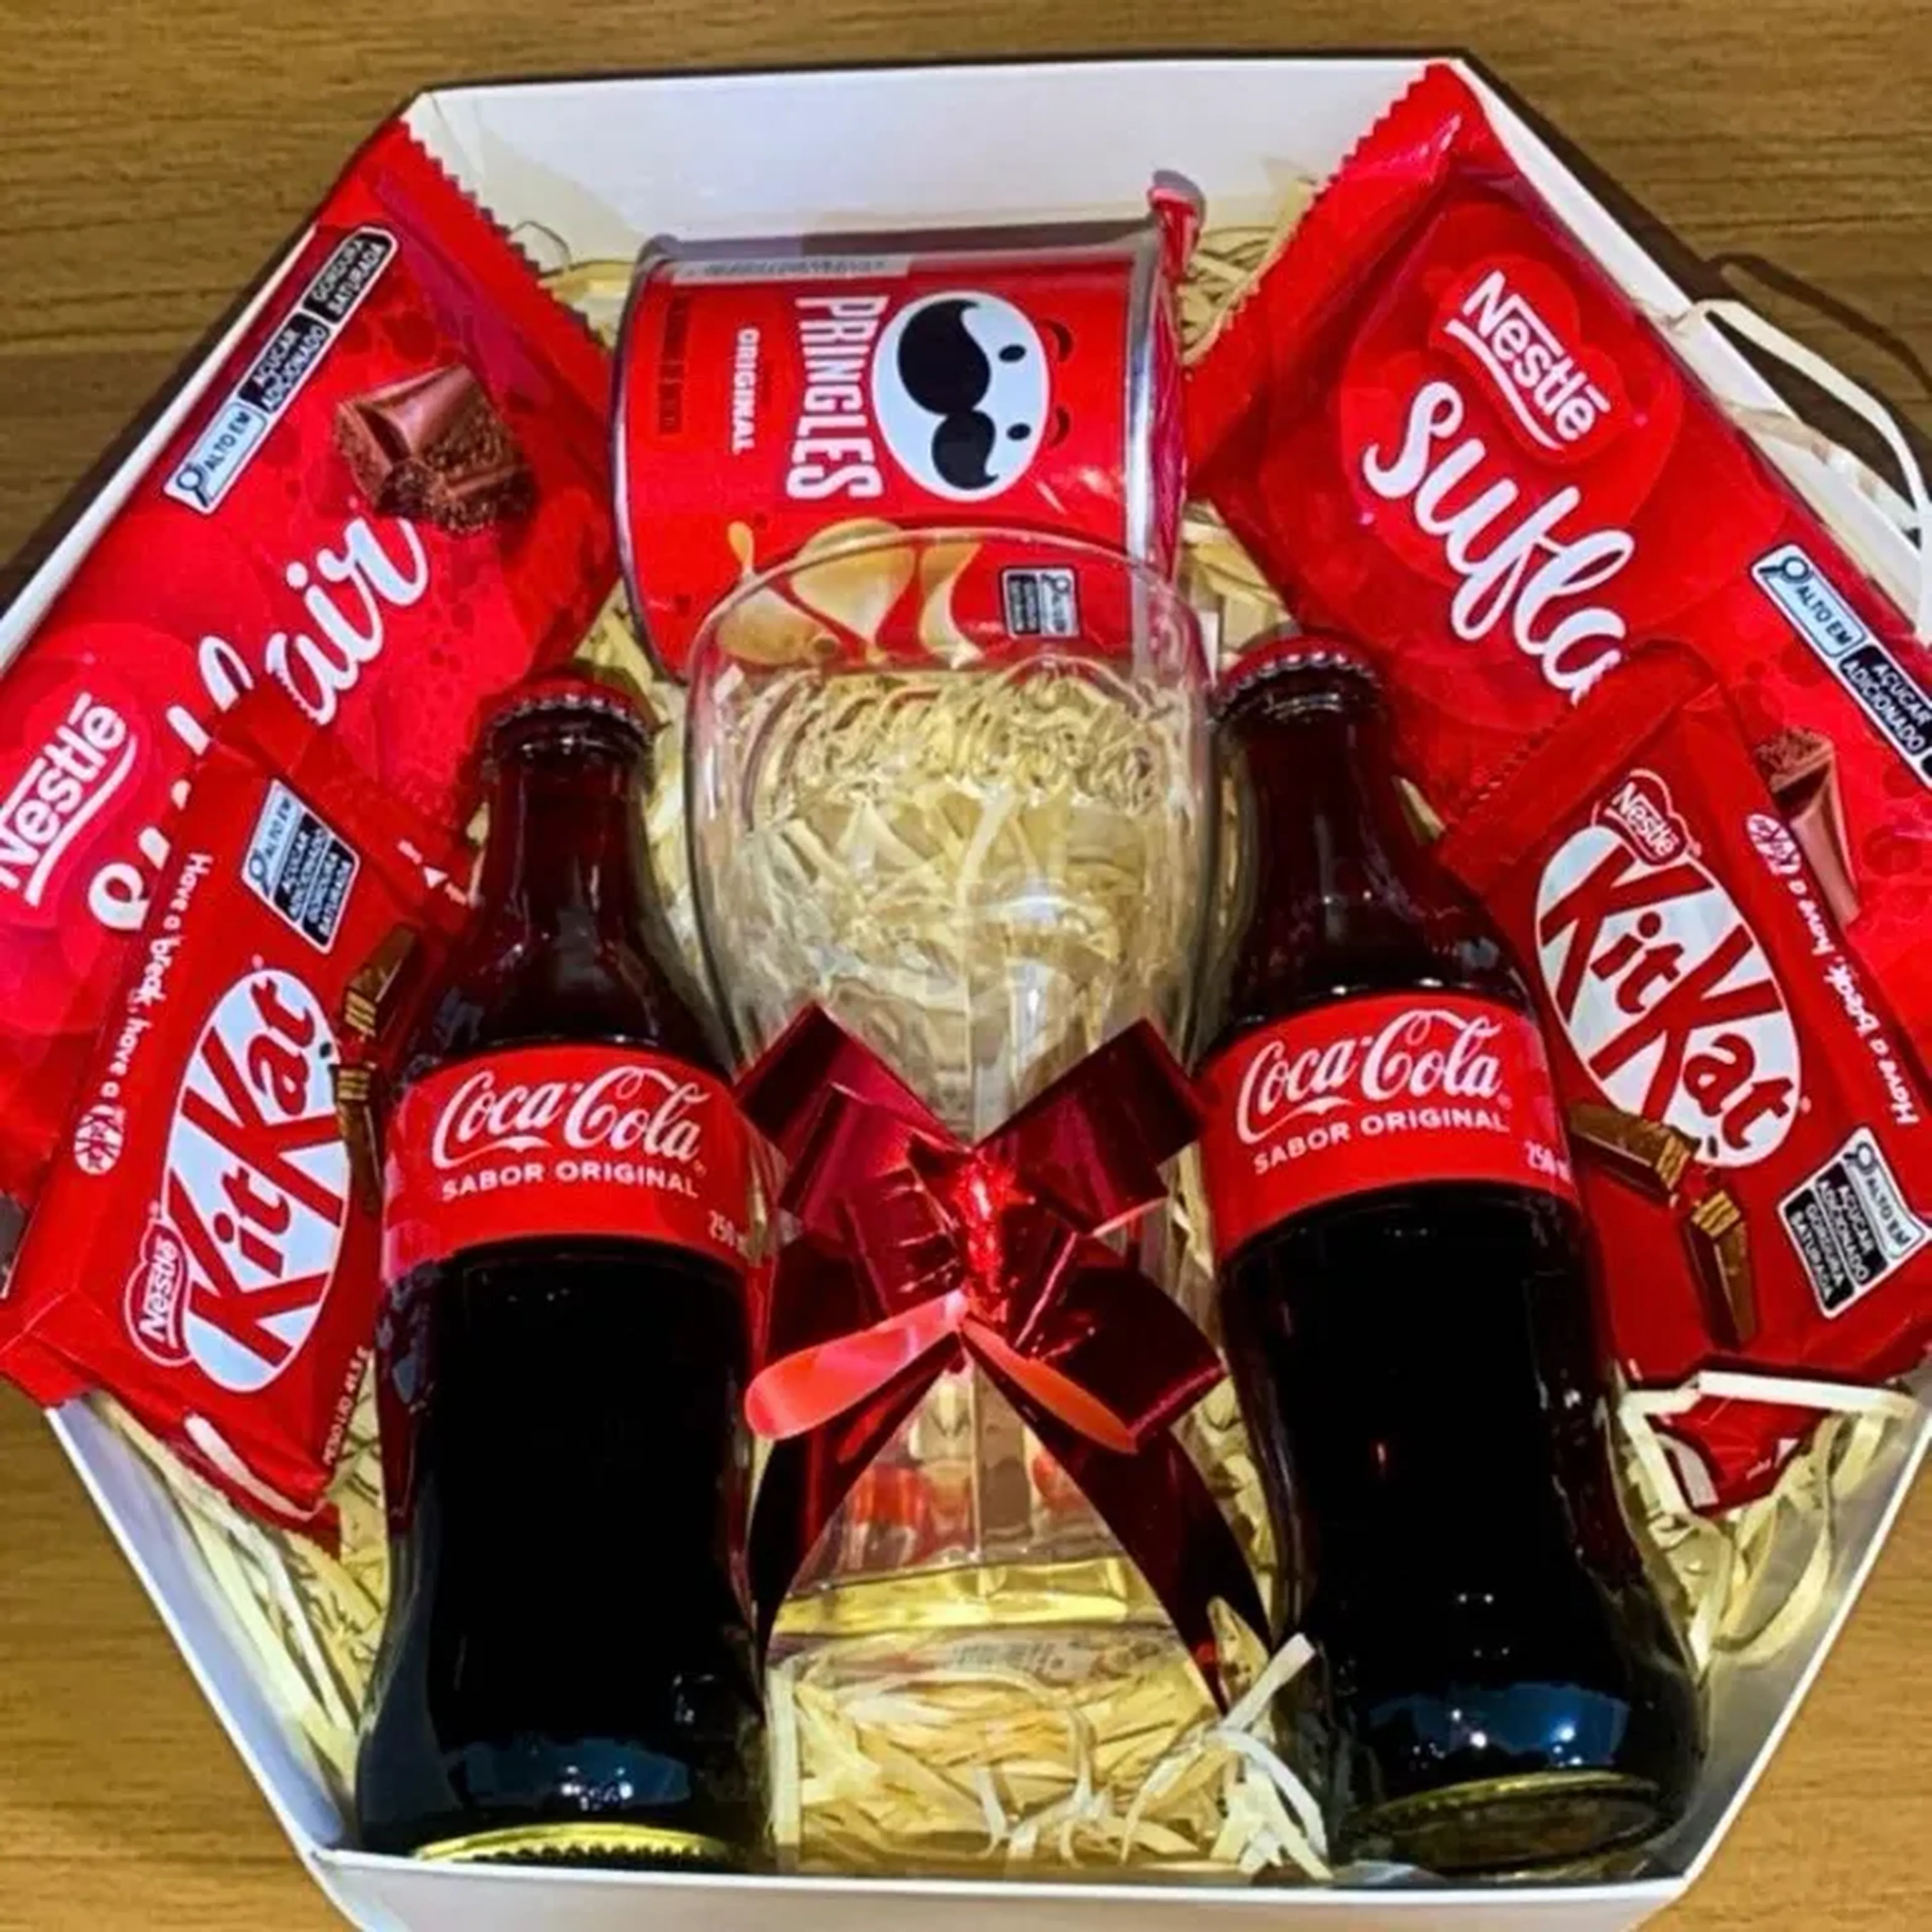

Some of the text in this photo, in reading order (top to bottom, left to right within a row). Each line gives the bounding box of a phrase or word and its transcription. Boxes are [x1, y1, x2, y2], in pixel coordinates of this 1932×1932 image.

[328, 243, 386, 315] SATURADA
[261, 325, 328, 408] ADICIONADO
[733, 327, 760, 454] ORIGINAL
[1462, 270, 1611, 441] Nestlé
[785, 293, 890, 500] PRINGLES
[204, 412, 252, 472] ALTO EM
[1797, 584, 1854, 646] ALTO EM
[1843, 660, 1926, 752] ADICIONADO
[0, 692, 126, 890] Nestlé
[1612, 782, 1679, 856] Nestlé
[171, 852, 213, 911] Have
[1789, 880, 1807, 895] a
[164, 914, 181, 931] a
[1798, 899, 1836, 955] have
[1538, 844, 1794, 1151] KitKat
[109, 1016, 152, 1076] have
[1237, 1009, 1502, 1145] Coca-Cola
[1870, 1038, 1889, 1055] a
[101, 1082, 120, 1098] a
[432, 1065, 711, 1169] Coca-Cola
[1879, 1059, 1919, 1124] Have
[168, 977, 345, 1368] KitKat
[1253, 1106, 1509, 1176] SABOR ORIGINAL
[441, 1159, 699, 1202] SABOR ORIGINAL
[1866, 1177, 1912, 1245] ALTO EM
[1790, 1211, 1833, 1301] SATURADA
[1805, 1203, 1844, 1287] GORDURA
[1817, 1179, 1870, 1280] ADICIONADO
[138, 1237, 178, 1342] Nestlé
